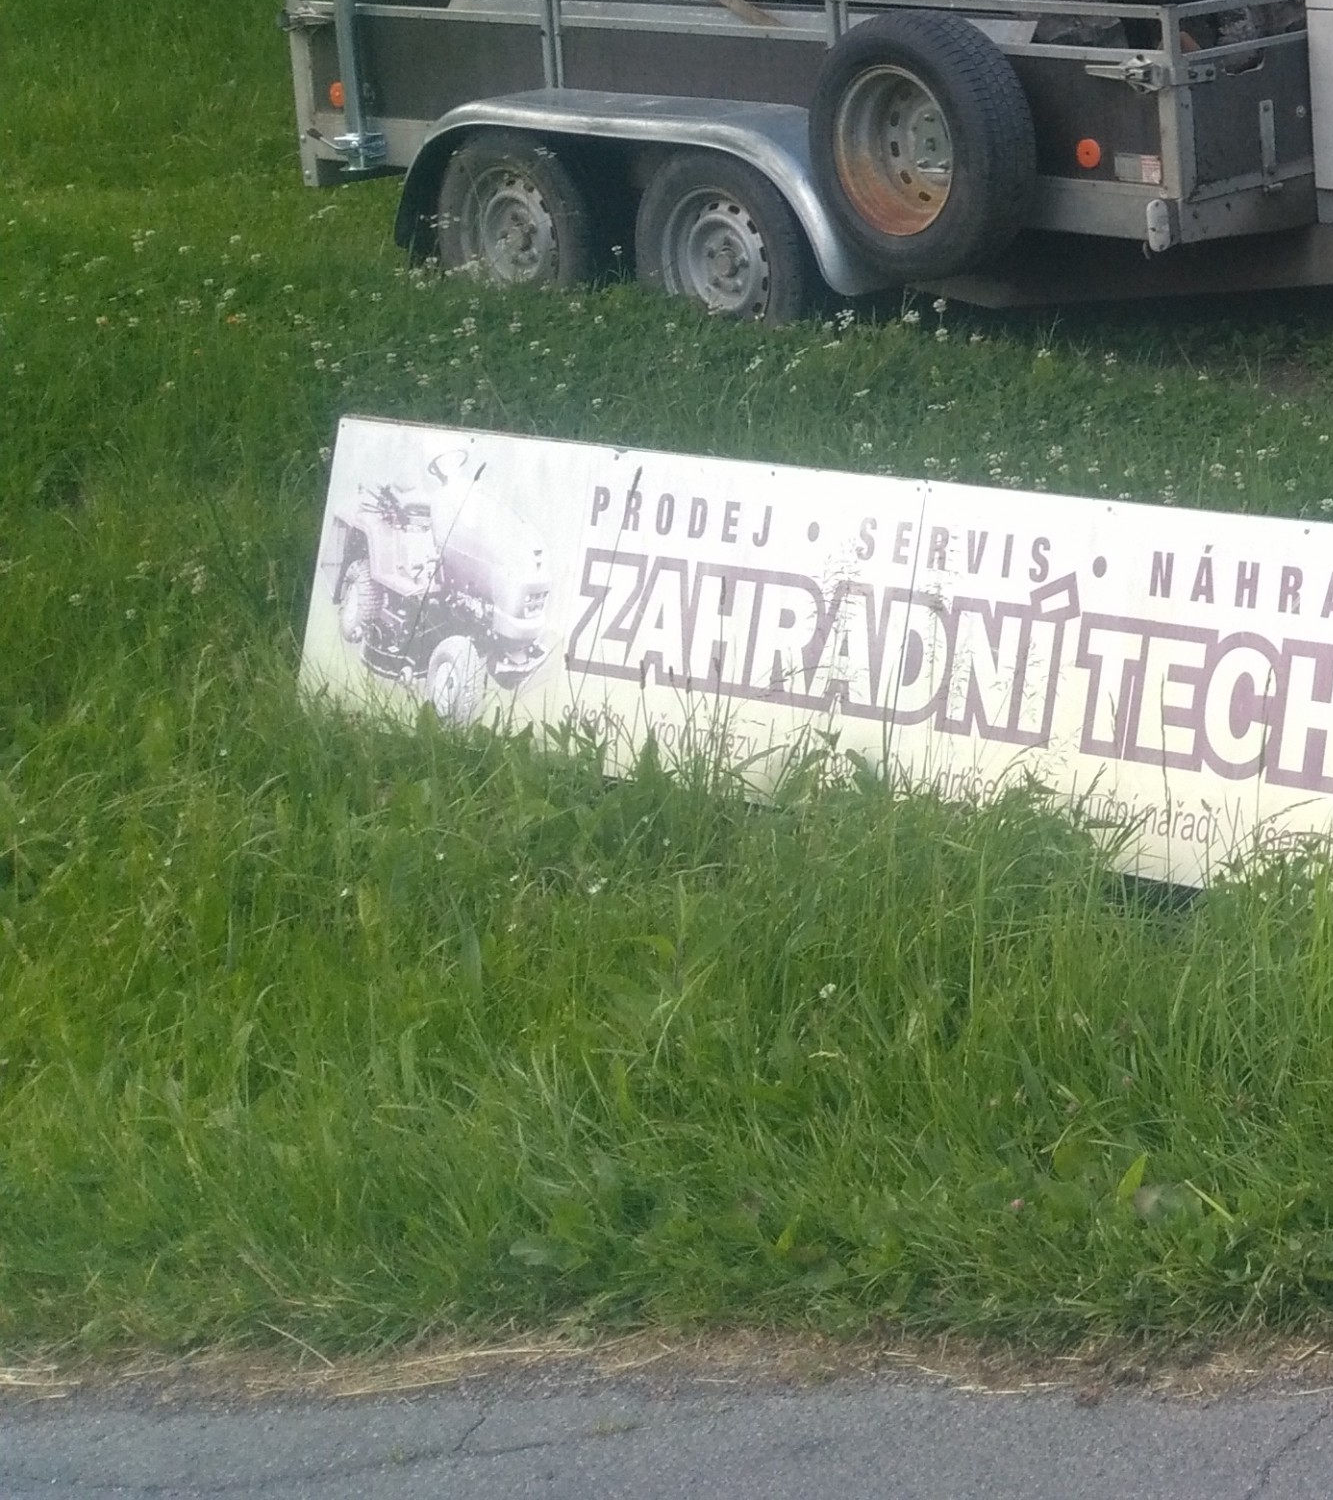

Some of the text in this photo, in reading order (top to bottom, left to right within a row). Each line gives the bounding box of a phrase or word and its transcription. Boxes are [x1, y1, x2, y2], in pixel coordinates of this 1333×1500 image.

[590, 486, 772, 547] PRODEJ
[858, 516, 1052, 582] SERVIS
[564, 547, 1079, 747] ZAHRADNÍ
